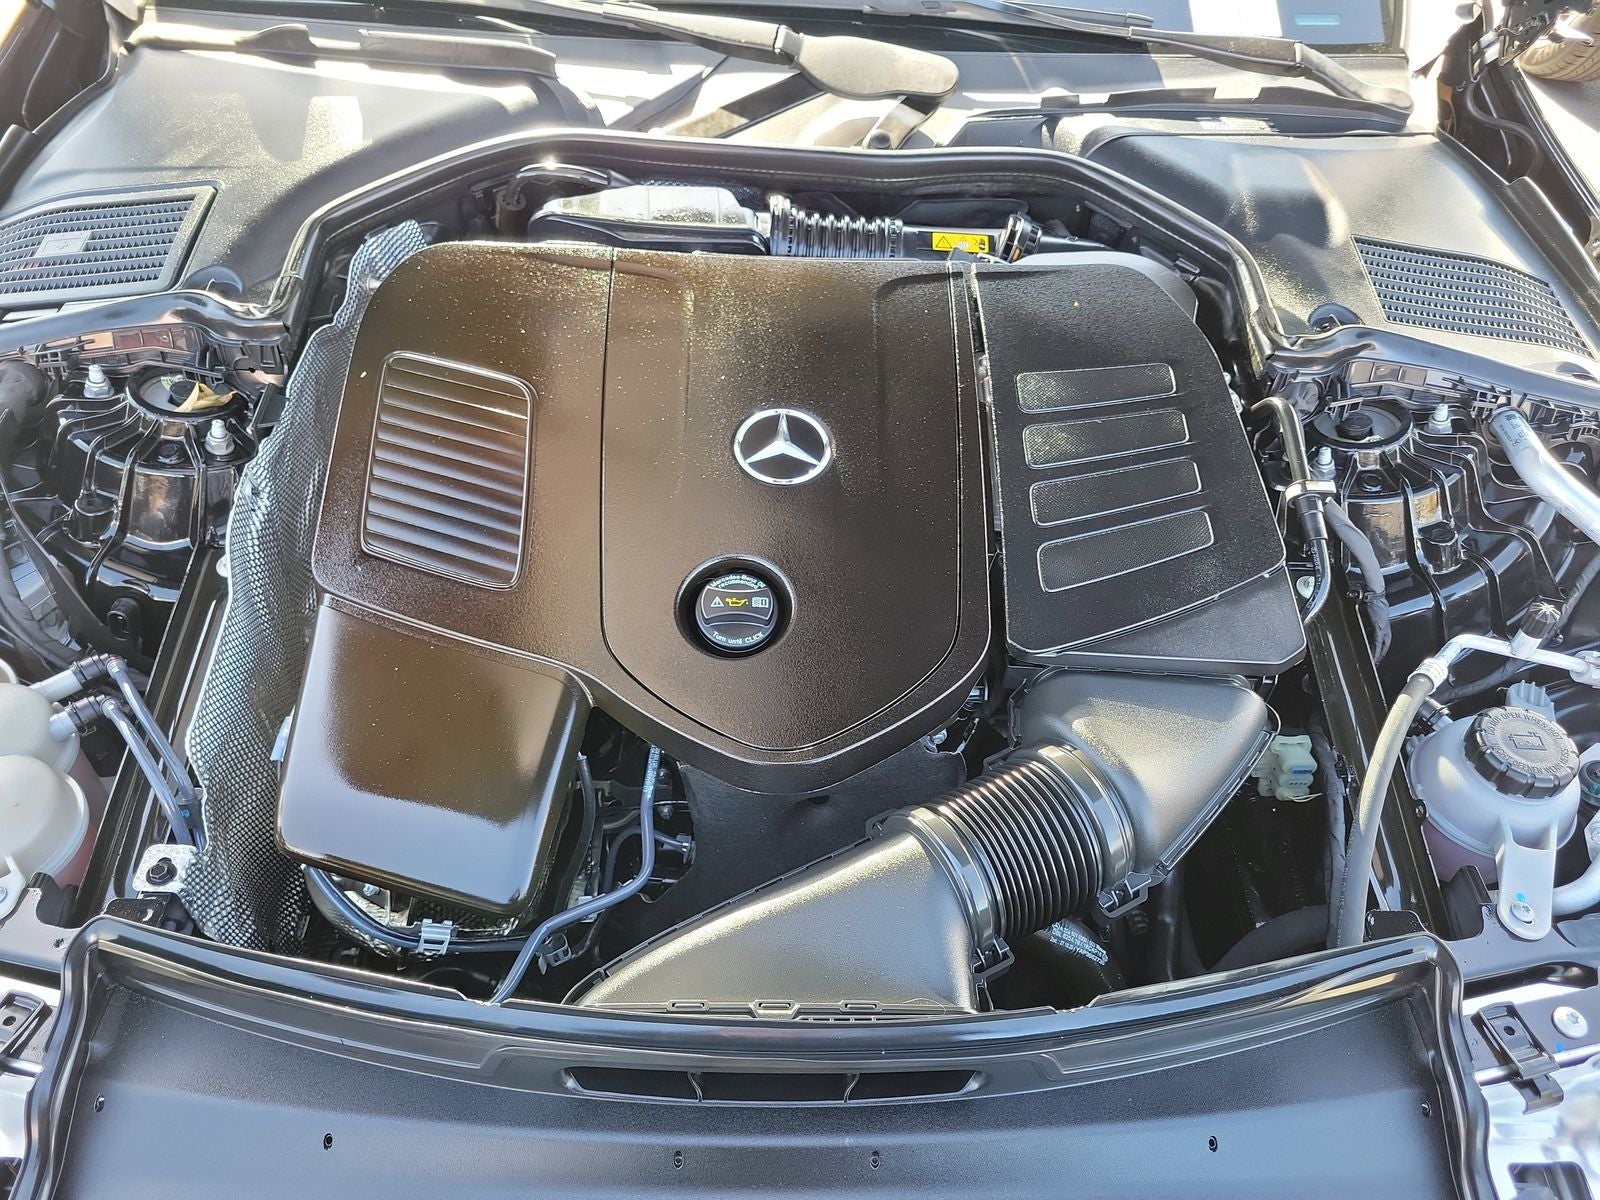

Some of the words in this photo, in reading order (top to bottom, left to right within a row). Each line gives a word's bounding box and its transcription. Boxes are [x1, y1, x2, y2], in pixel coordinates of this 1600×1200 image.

[713, 631, 726, 642] Turn
[745, 631, 764, 643] CLICK
[1501, 711, 1522, 720] OPEN
[1523, 713, 1548, 728] WHEN
[1548, 727, 1564, 740] HOT
